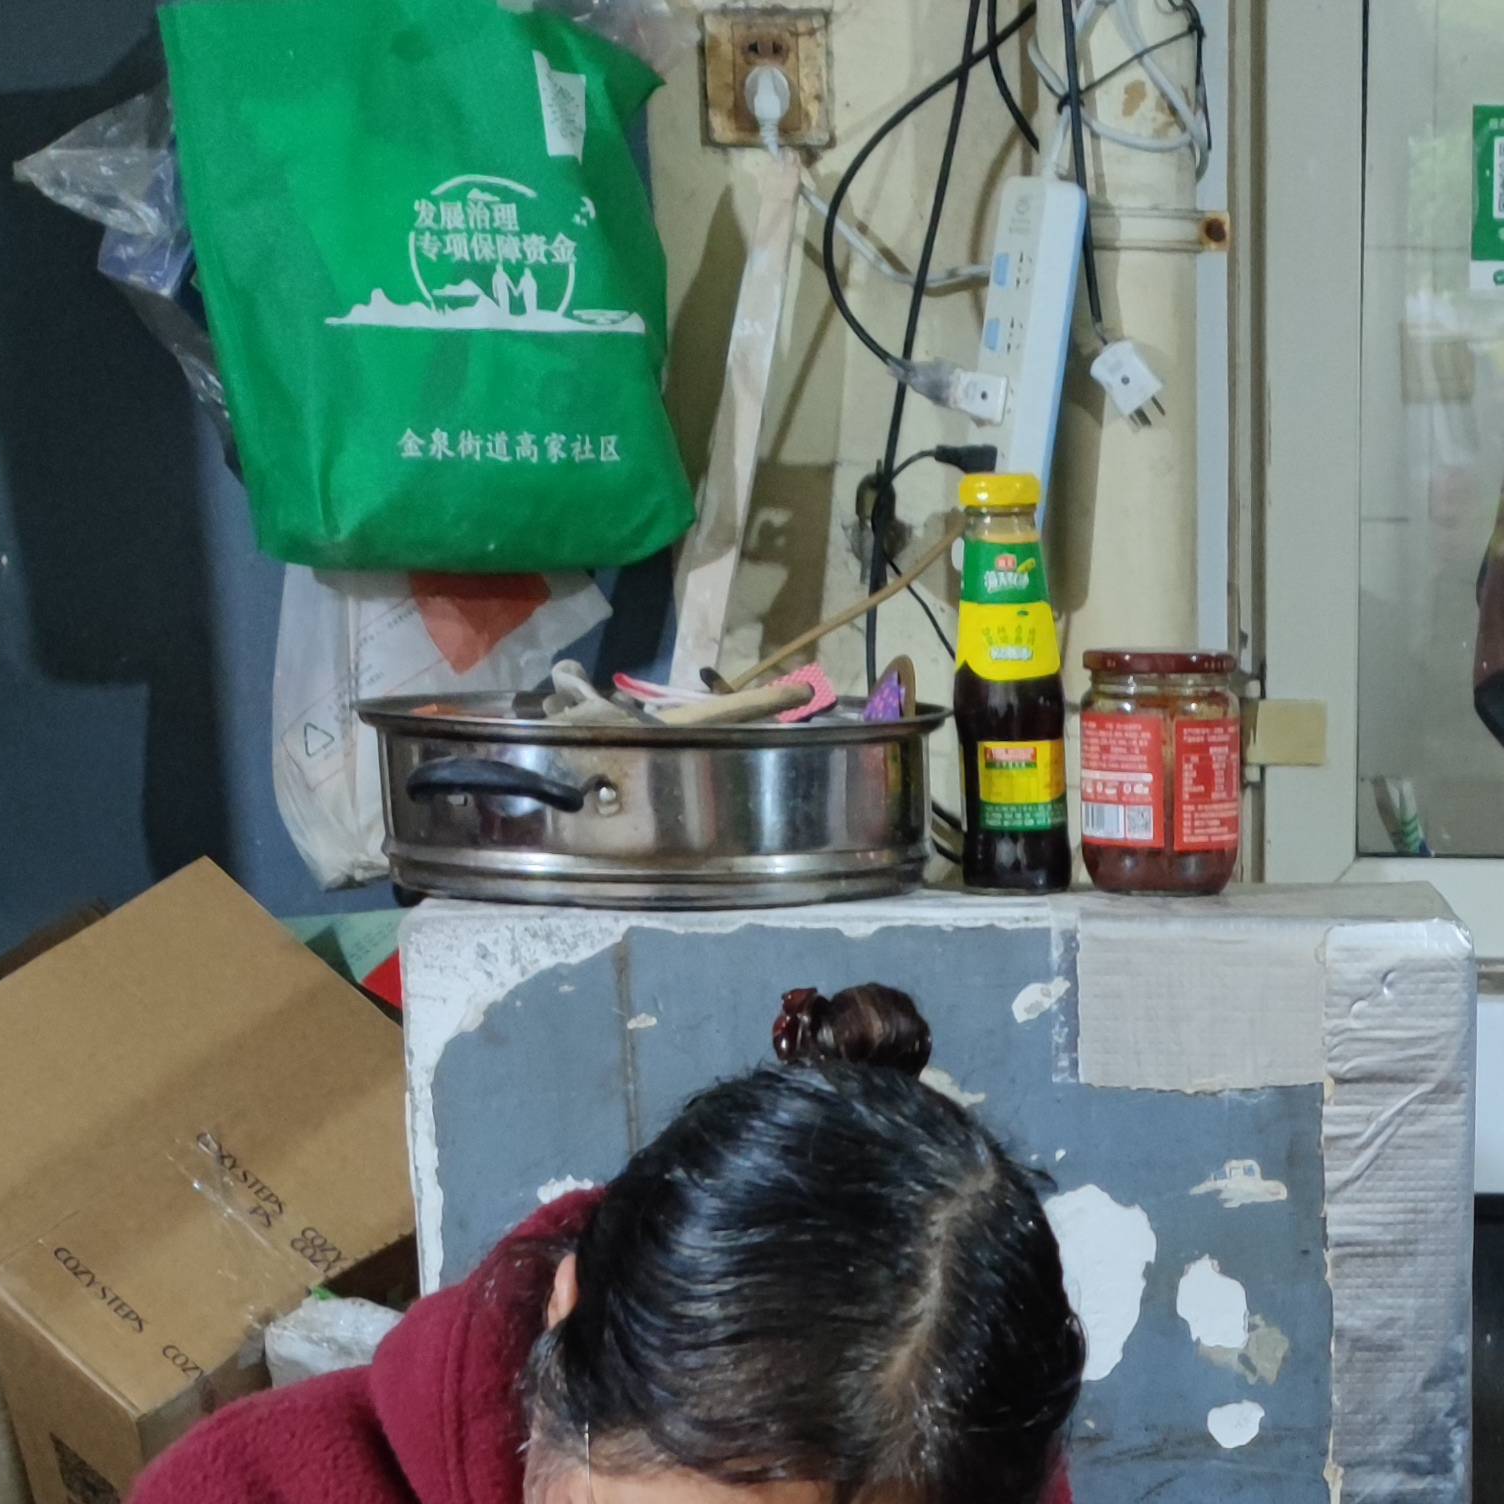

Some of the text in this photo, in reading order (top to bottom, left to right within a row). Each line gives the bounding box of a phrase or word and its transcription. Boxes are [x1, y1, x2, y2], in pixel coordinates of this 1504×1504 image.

[414, 199, 520, 231] 发展治理
[416, 232, 576, 264] 专项保障资金
[398, 427, 620, 463] 金泉街道高家社区
[53, 1247, 98, 1288] COZY
[97, 1284, 147, 1334] STEPS
